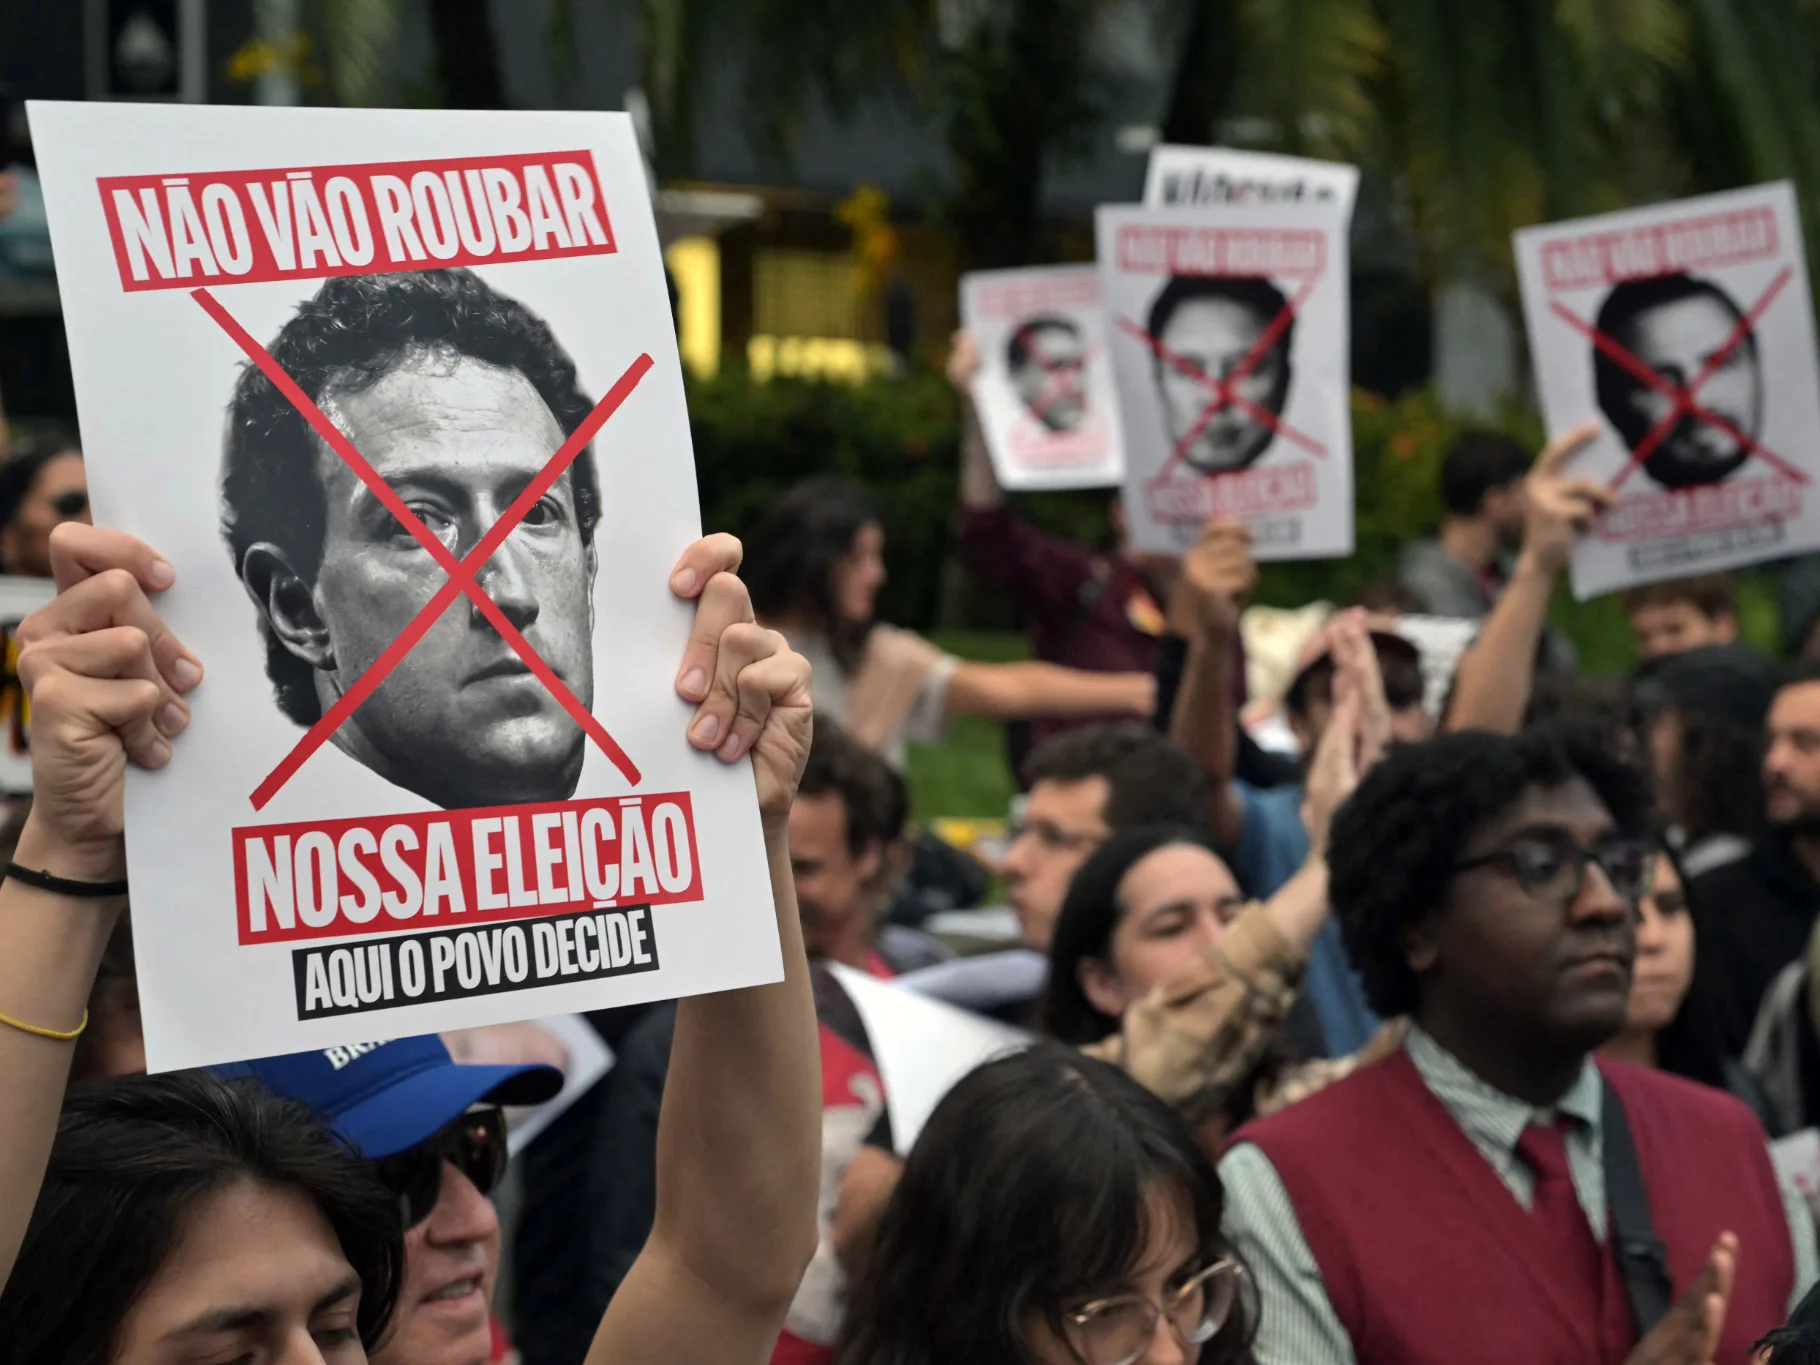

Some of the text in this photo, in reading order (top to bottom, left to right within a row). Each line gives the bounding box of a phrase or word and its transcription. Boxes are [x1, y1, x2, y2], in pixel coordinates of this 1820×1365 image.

[111, 162, 608, 282] NÃO VÃO ROUBAR
[244, 797, 694, 933] NOSSA ELEIÇÃO
[304, 910, 653, 1011] AQUI O POVO DECIDE
